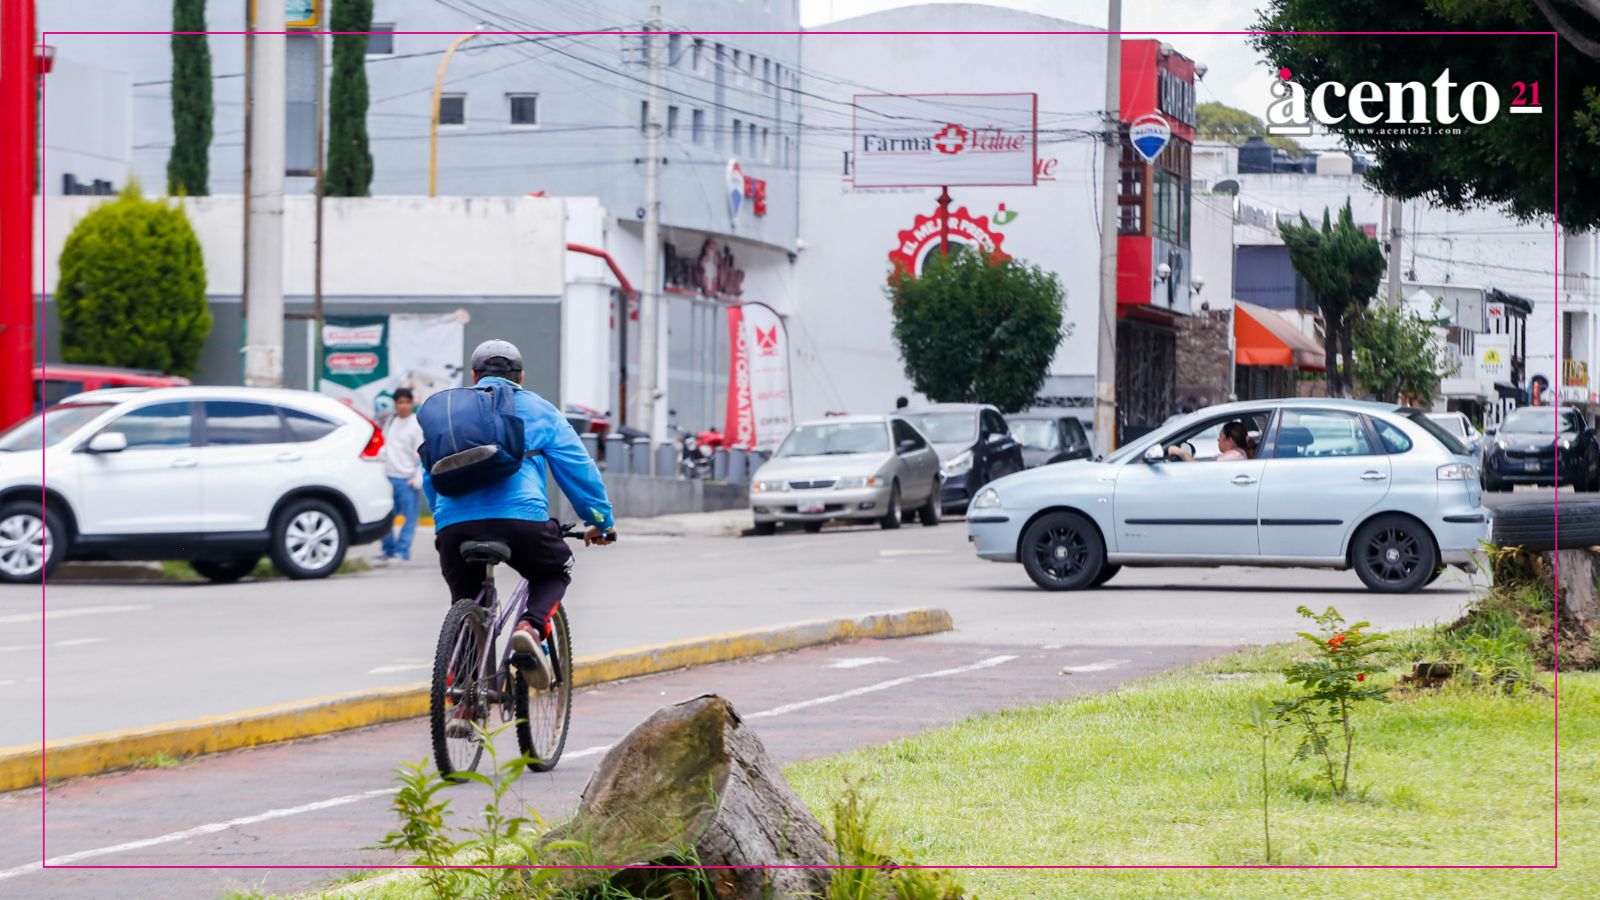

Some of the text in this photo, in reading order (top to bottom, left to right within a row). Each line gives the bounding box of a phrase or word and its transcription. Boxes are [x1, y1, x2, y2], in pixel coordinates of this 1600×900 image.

[863, 134, 932, 151] Farma
[902, 241, 919, 256] EL
[914, 217, 959, 242] MEJR
